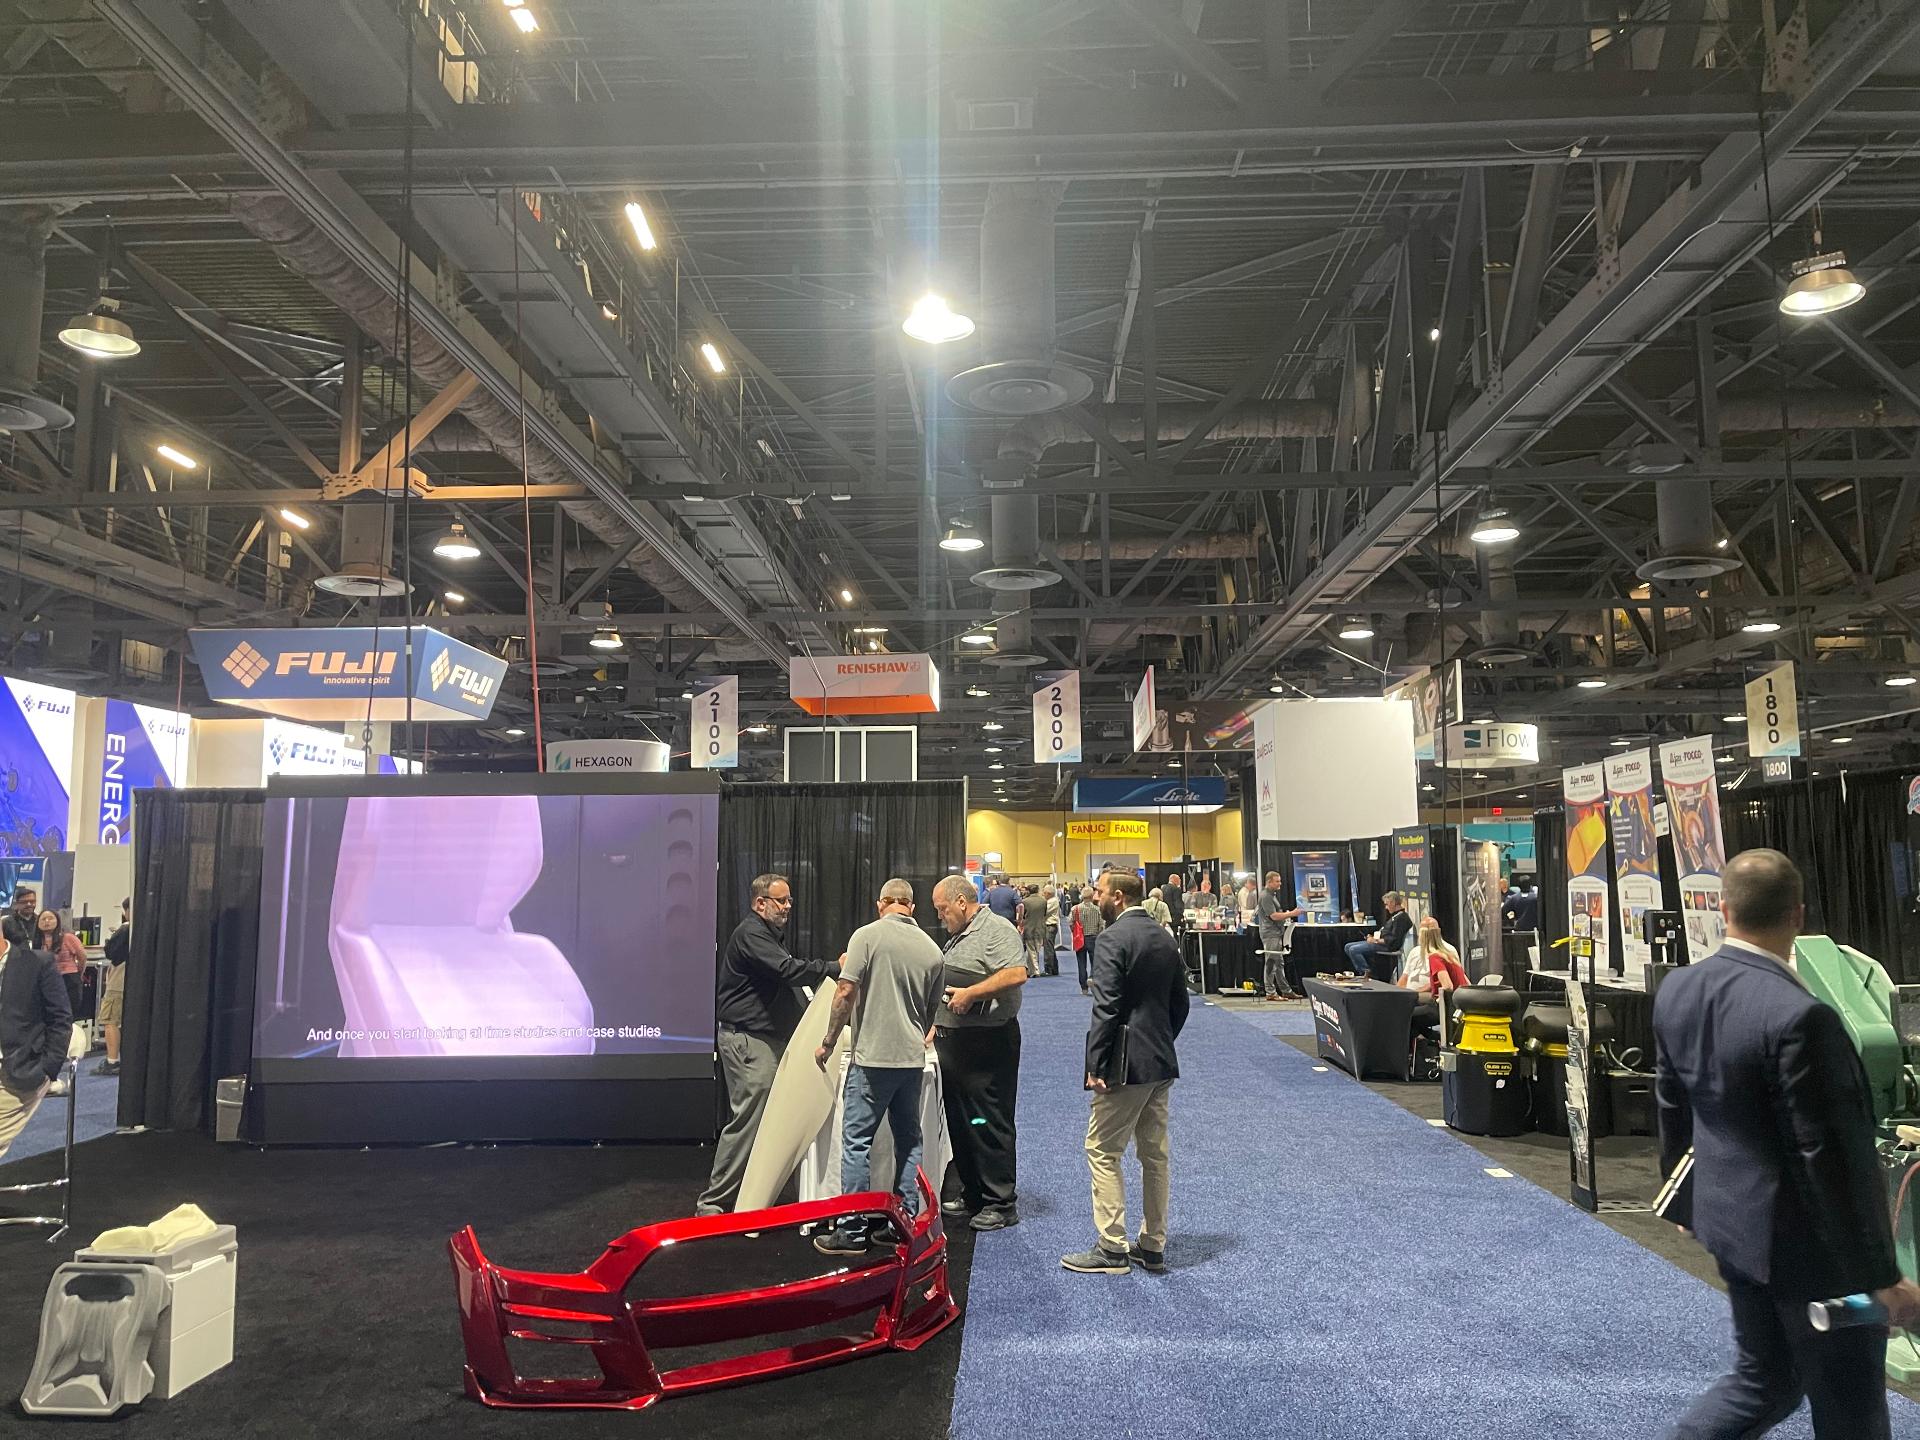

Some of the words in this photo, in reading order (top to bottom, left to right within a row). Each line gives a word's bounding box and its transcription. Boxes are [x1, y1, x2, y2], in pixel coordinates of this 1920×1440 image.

[275, 651, 397, 675] FUJI
[837, 662, 909, 675] RENISHAW
[323, 676, 366, 685] innovative
[368, 676, 390, 686] spirit
[448, 665, 494, 696] FUJI
[37, 700, 71, 715] FUJI
[1766, 677, 1780, 744] 1800
[709, 691, 720, 756] 2100
[1051, 686, 1063, 751] 2000
[1487, 728, 1530, 748] Flow
[290, 742, 336, 765] FUJI
[575, 756, 633, 767] HEXAGON
[1765, 761, 1787, 777] 1800
[101, 733, 126, 845] ENERG
[1154, 787, 1200, 802] Linde
[1071, 824, 1106, 834] FANUC
[1114, 824, 1146, 834] FANUC
[306, 1027, 332, 1041] And
[334, 1030, 365, 1040] once
[368, 1030, 390, 1043] you
[393, 1028, 420, 1039] start
[423, 1026, 467, 1041] looking
[470, 1026, 482, 1039] at
[485, 1025, 511, 1038] time
[514, 1024, 557, 1039] studies
[560, 1025, 583, 1037] and
[586, 1027, 615, 1038] case
[618, 1024, 662, 1038] studies
